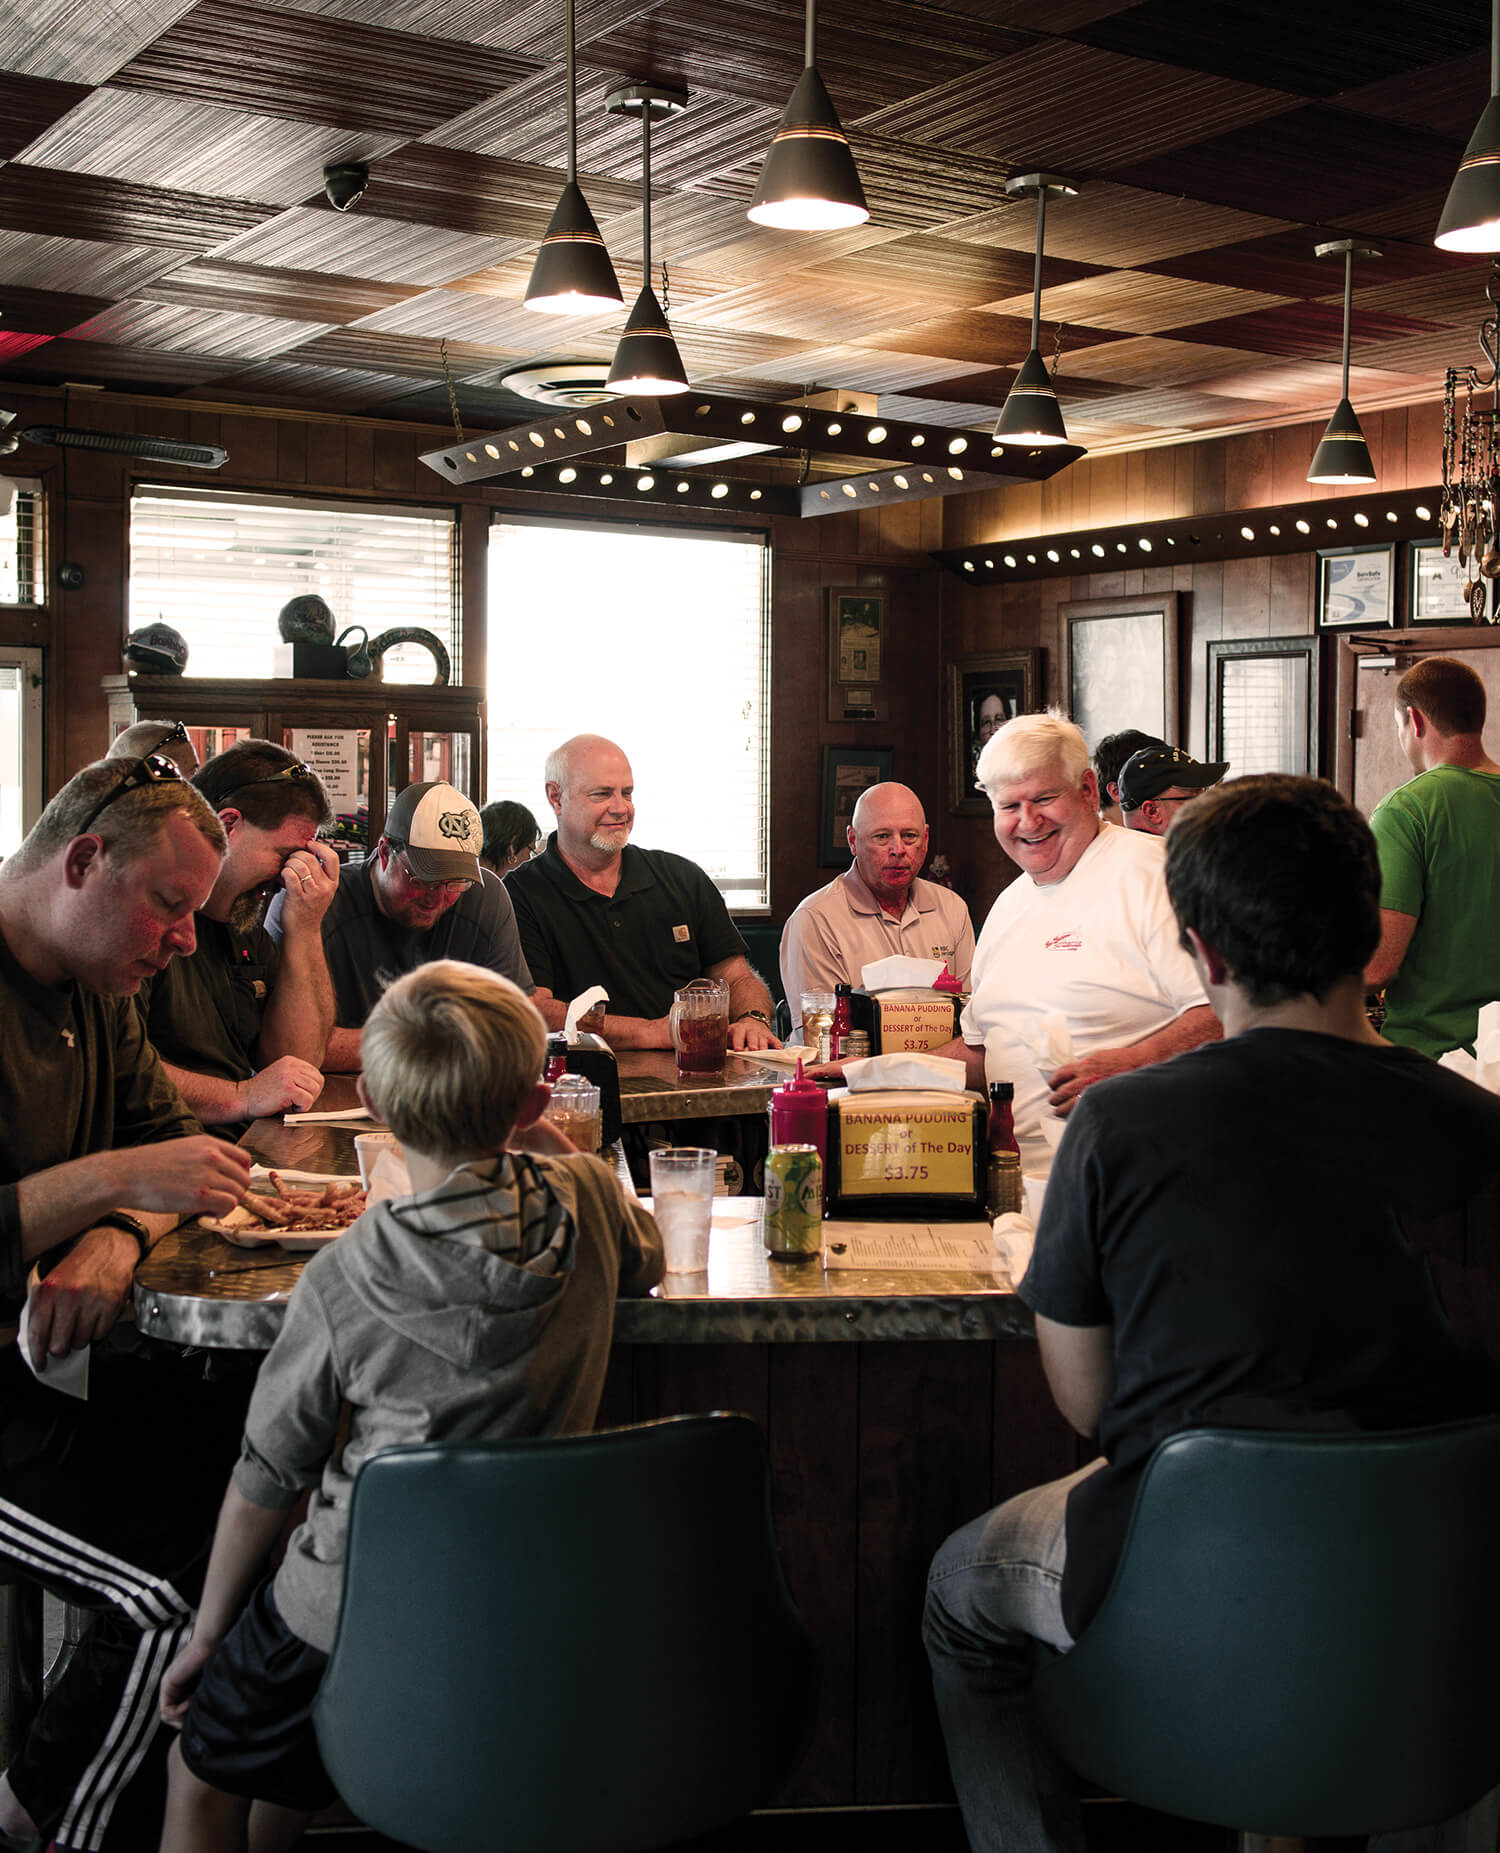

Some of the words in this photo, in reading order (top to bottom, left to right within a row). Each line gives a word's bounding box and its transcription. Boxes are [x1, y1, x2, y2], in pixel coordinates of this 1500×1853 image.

[883, 1024, 914, 1032] DESSERT
[915, 1024, 923, 1032] of
[925, 1024, 938, 1032] The
[939, 1024, 952, 1034] Day
[904, 1039, 929, 1050] $3.75
[845, 1114, 902, 1125] BANANA
[905, 1112, 967, 1124] PUDDING
[899, 1129, 912, 1139] or
[845, 1143, 899, 1155] DESSERT
[904, 1142, 916, 1153] of
[920, 1141, 944, 1153] The
[947, 1142, 972, 1156] Day
[884, 1165, 929, 1181] $3.75
